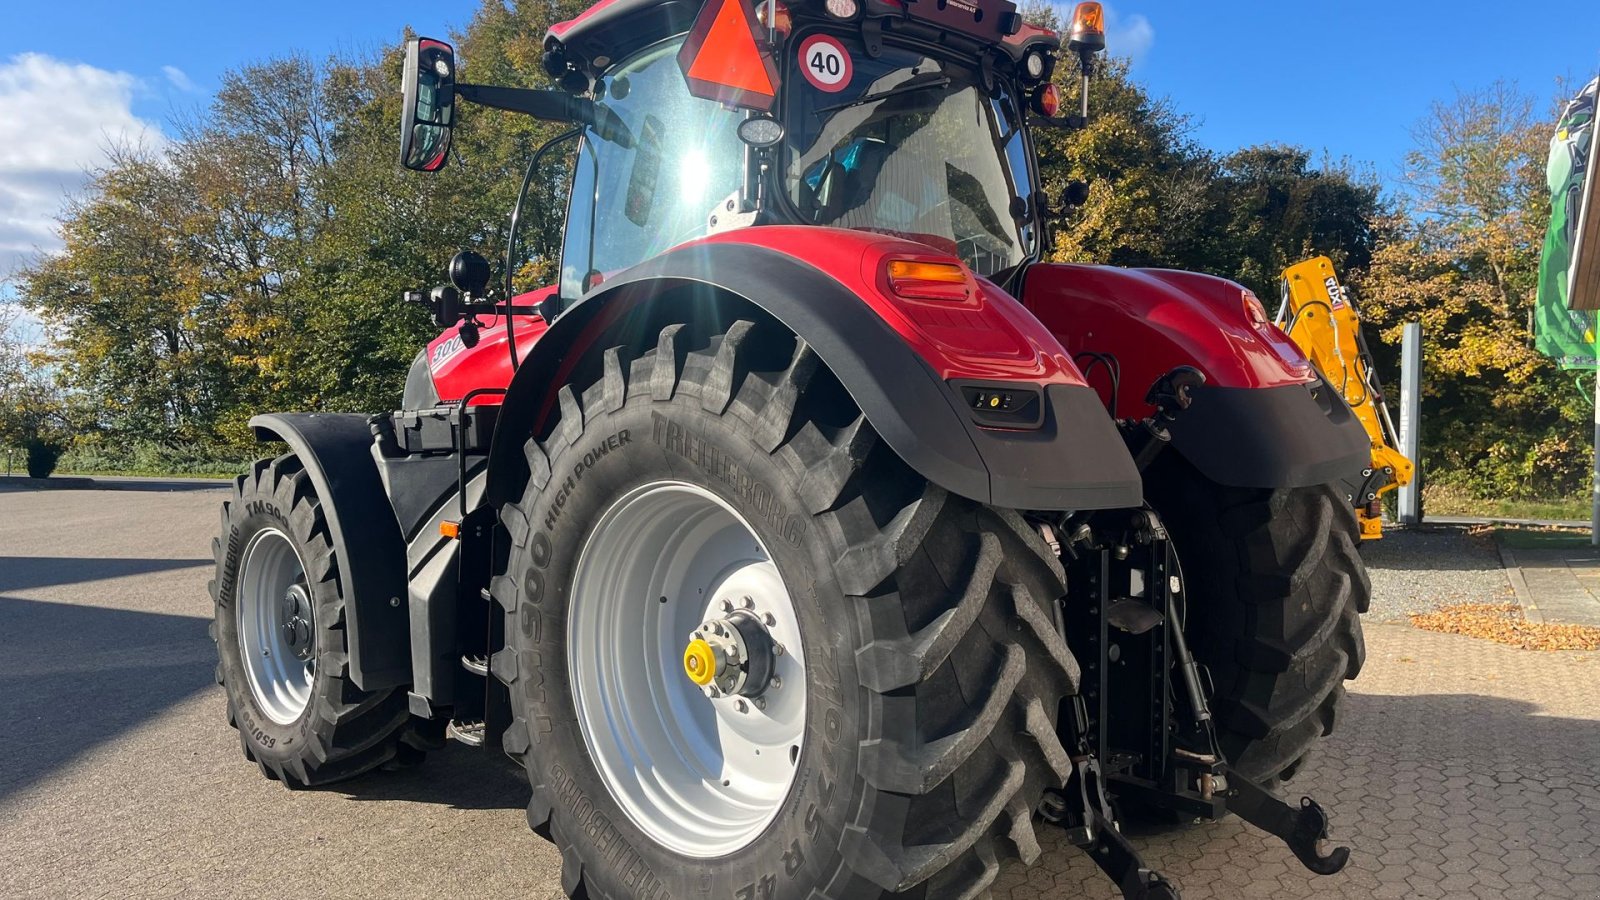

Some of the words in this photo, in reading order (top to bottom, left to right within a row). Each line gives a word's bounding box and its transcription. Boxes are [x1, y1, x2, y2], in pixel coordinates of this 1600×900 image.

[811, 51, 840, 76] 40
[433, 335, 462, 363] 300
[651, 409, 806, 549] TRELLEBORG
[245, 499, 291, 530] TM900
[218, 523, 240, 609] TRELLEBORG
[521, 531, 552, 745] TM900
[544, 475, 576, 532] HIGH
[573, 428, 633, 480] POWER
